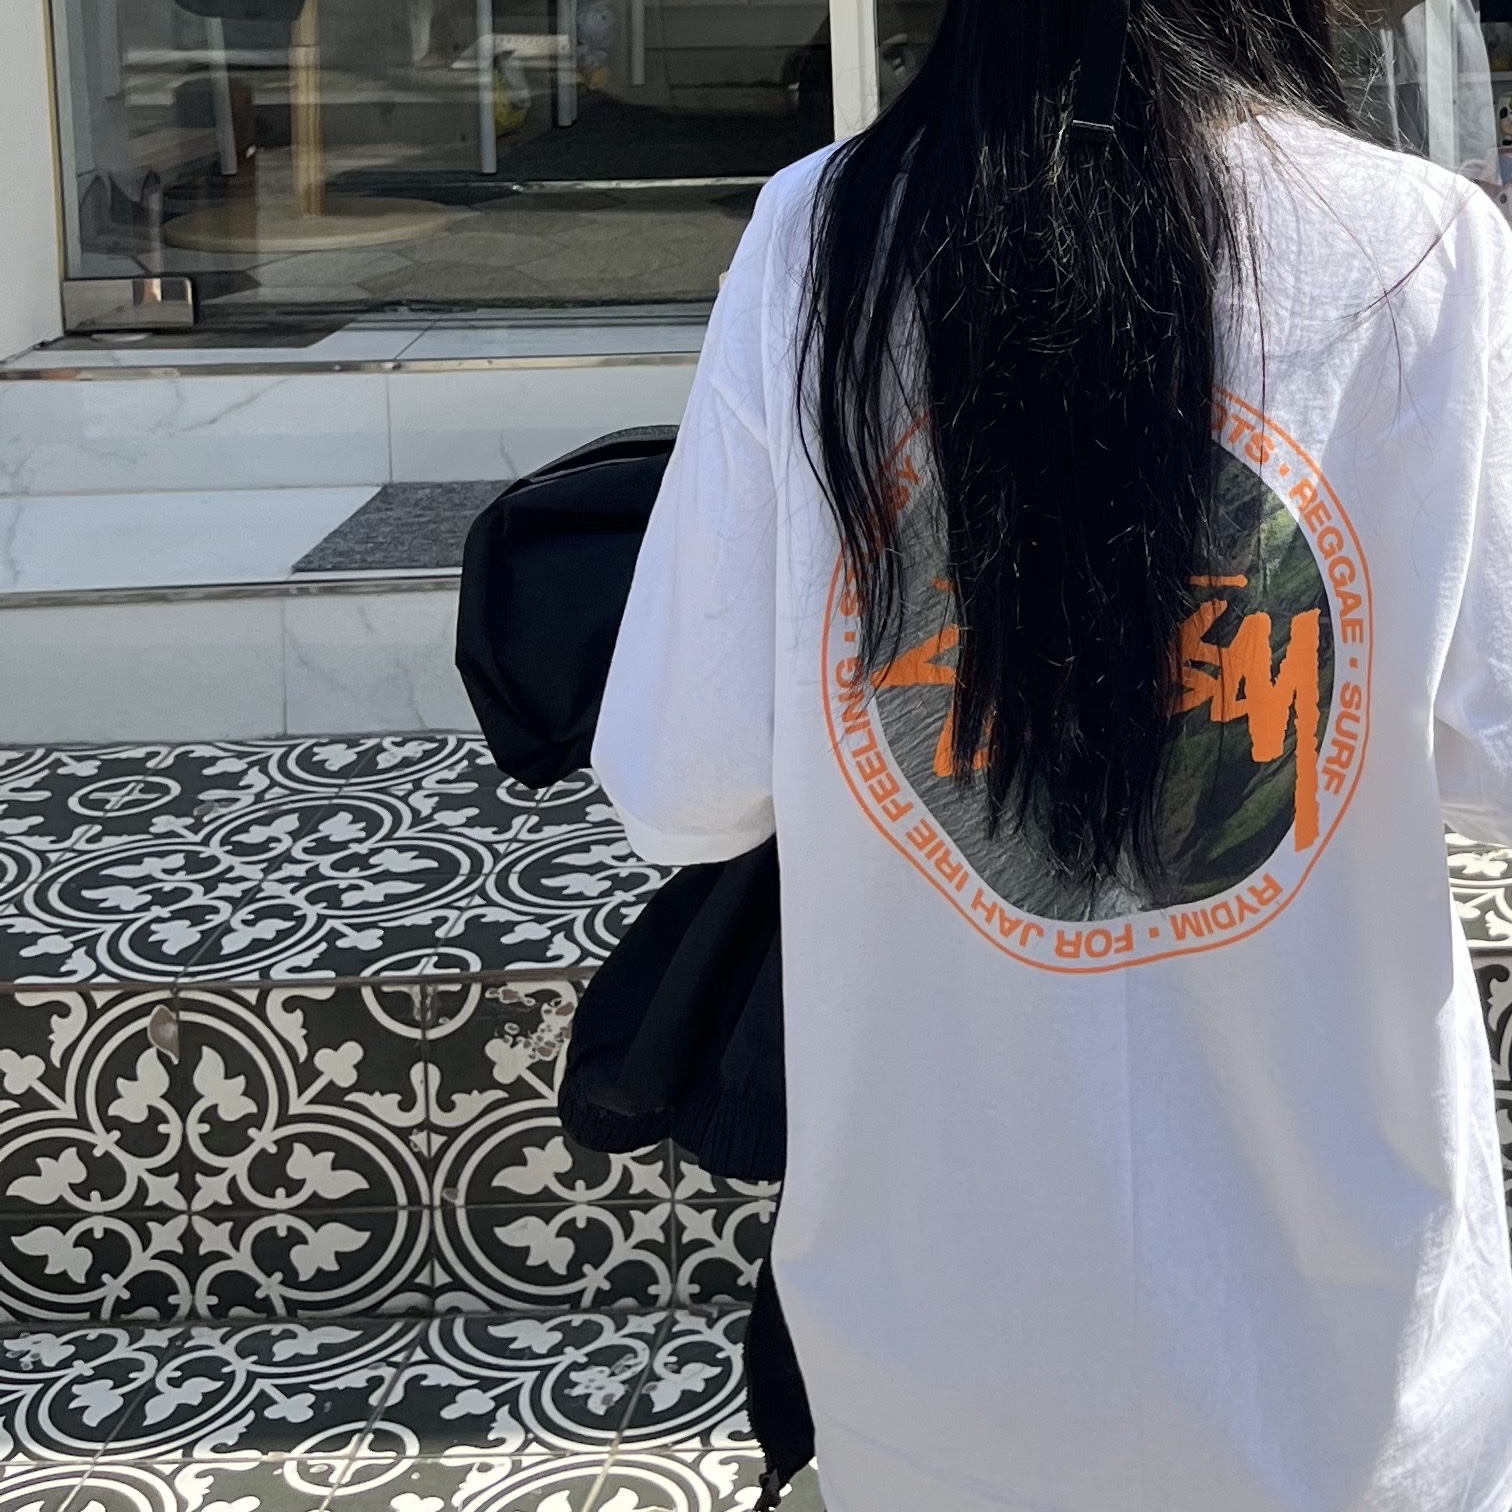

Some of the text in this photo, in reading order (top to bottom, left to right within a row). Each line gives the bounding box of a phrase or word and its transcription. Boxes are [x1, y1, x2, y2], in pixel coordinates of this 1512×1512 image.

[1288, 476, 1365, 645] REGGAE
[835, 654, 915, 824] FEELING
[1319, 680, 1363, 796] SURF
[904, 817, 971, 893] IRIE
[970, 887, 1135, 960] FOR JAH
[1169, 872, 1285, 942] RYDIM
